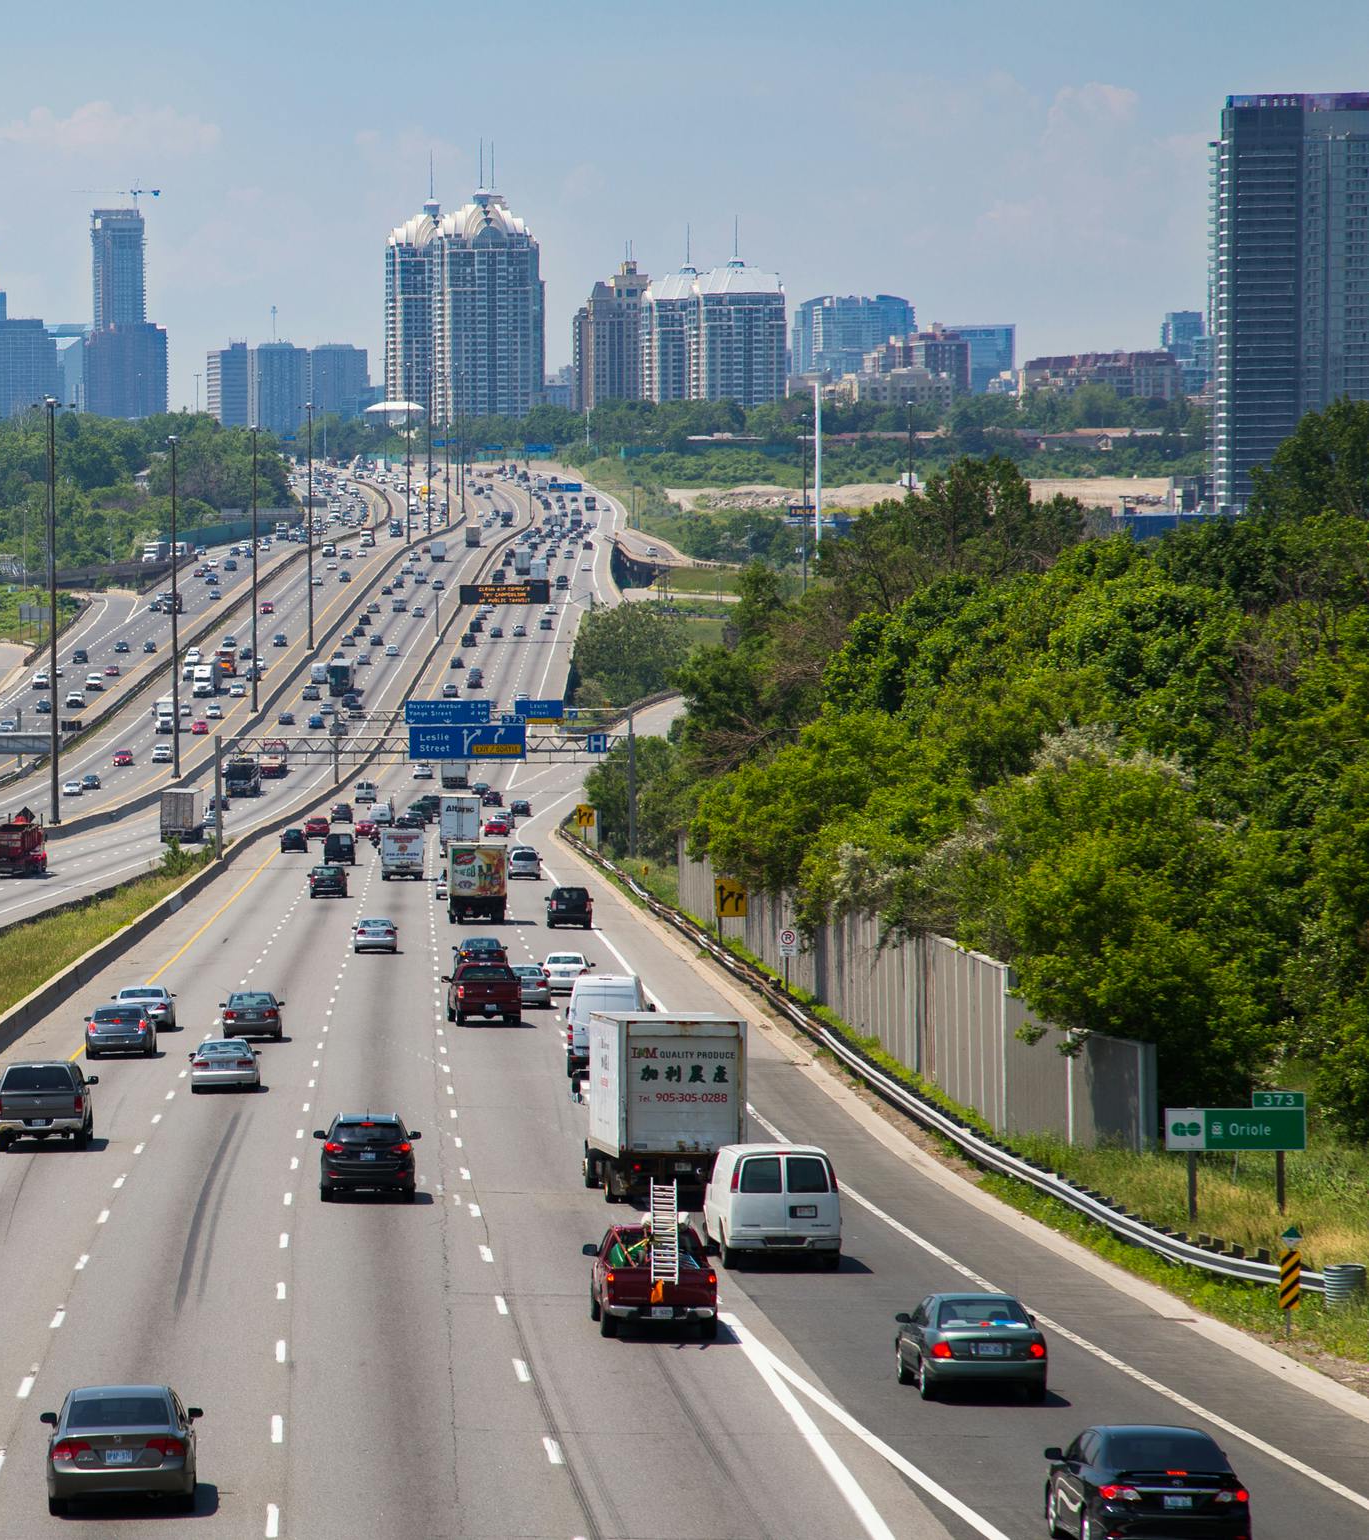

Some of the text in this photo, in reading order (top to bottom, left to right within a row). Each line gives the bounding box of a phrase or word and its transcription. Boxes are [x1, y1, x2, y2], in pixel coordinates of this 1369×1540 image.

[419, 733, 450, 742] Leslie
[419, 744, 450, 753] Street
[590, 736, 604, 751] H
[660, 1050, 695, 1059] QUALITY
[697, 1051, 736, 1060] PRODUCE
[656, 1093, 728, 1103] 905-305-0288
[1263, 1094, 1295, 1106] 373
[1229, 1122, 1272, 1136] Oriole
